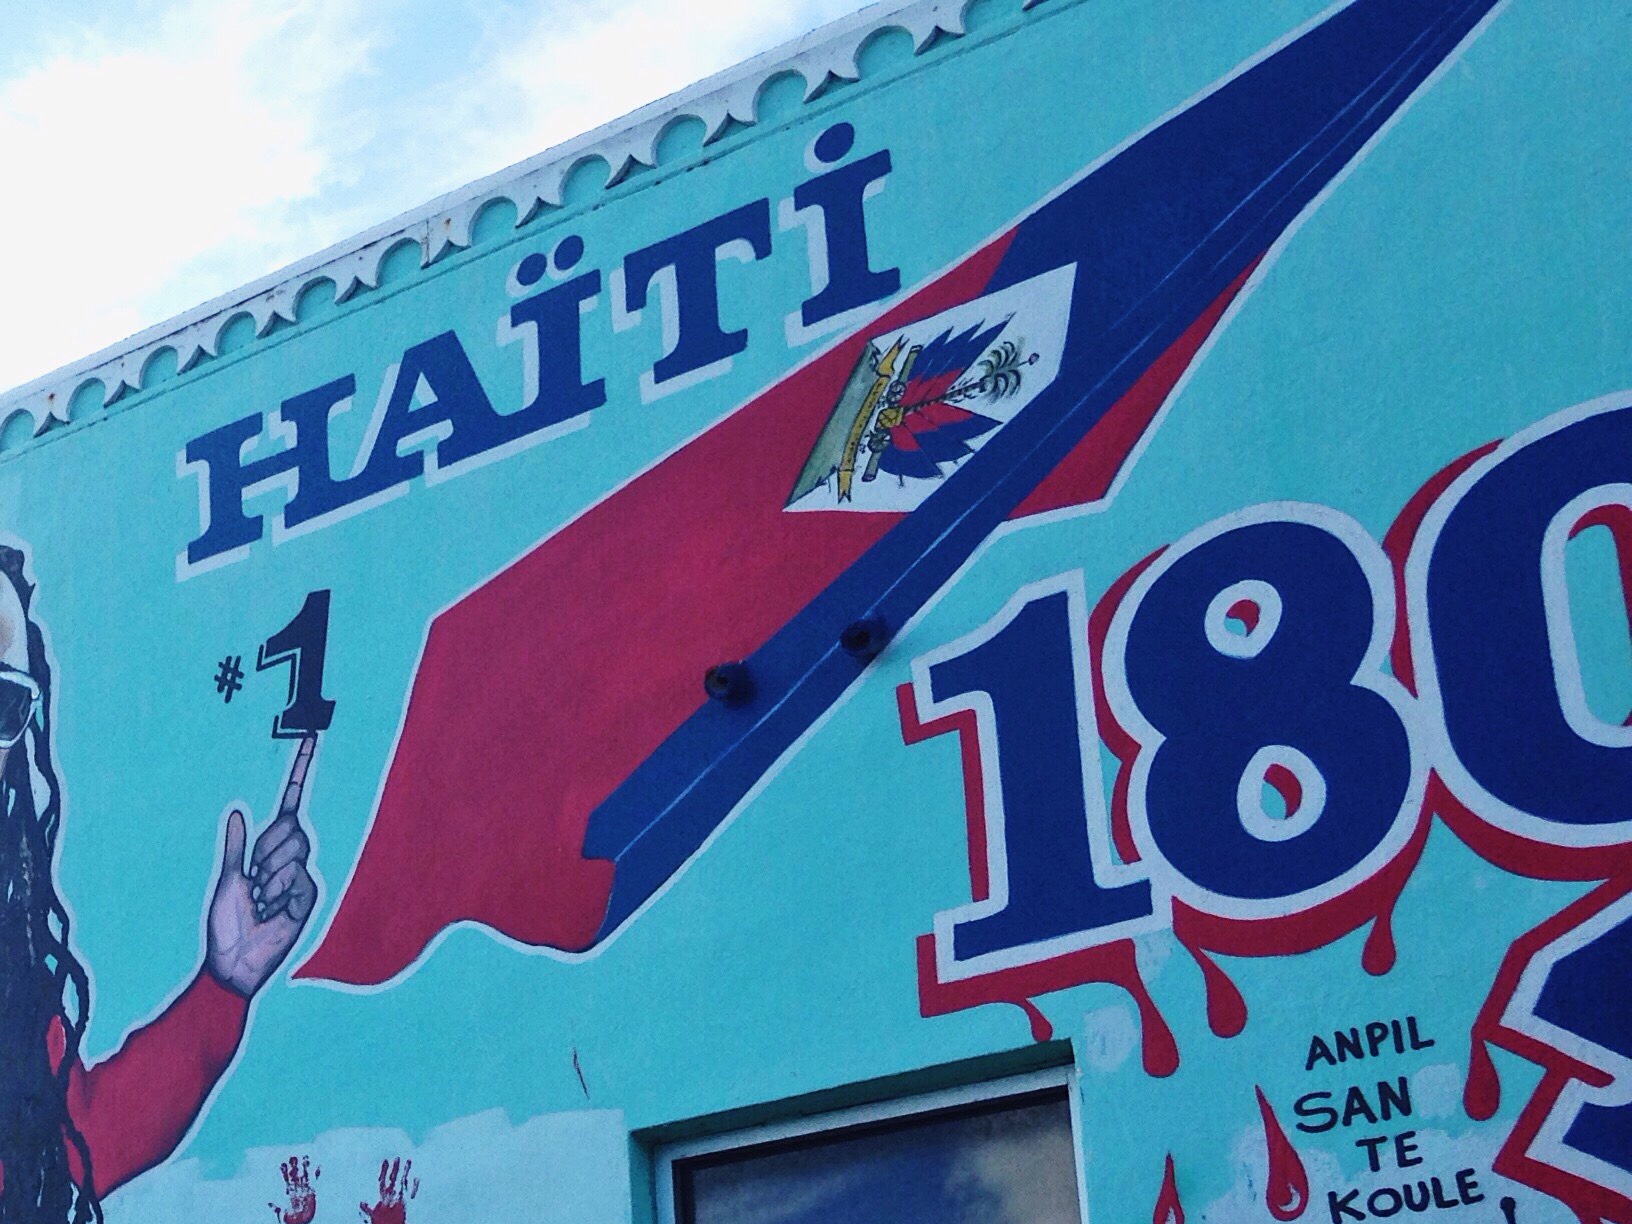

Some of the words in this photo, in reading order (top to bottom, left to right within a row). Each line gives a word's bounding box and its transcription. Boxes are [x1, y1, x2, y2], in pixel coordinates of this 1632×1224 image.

[1305, 1016, 1435, 1070] ANPIL
[1293, 1076, 1413, 1134] SAN
[1355, 1130, 1423, 1172] TE
